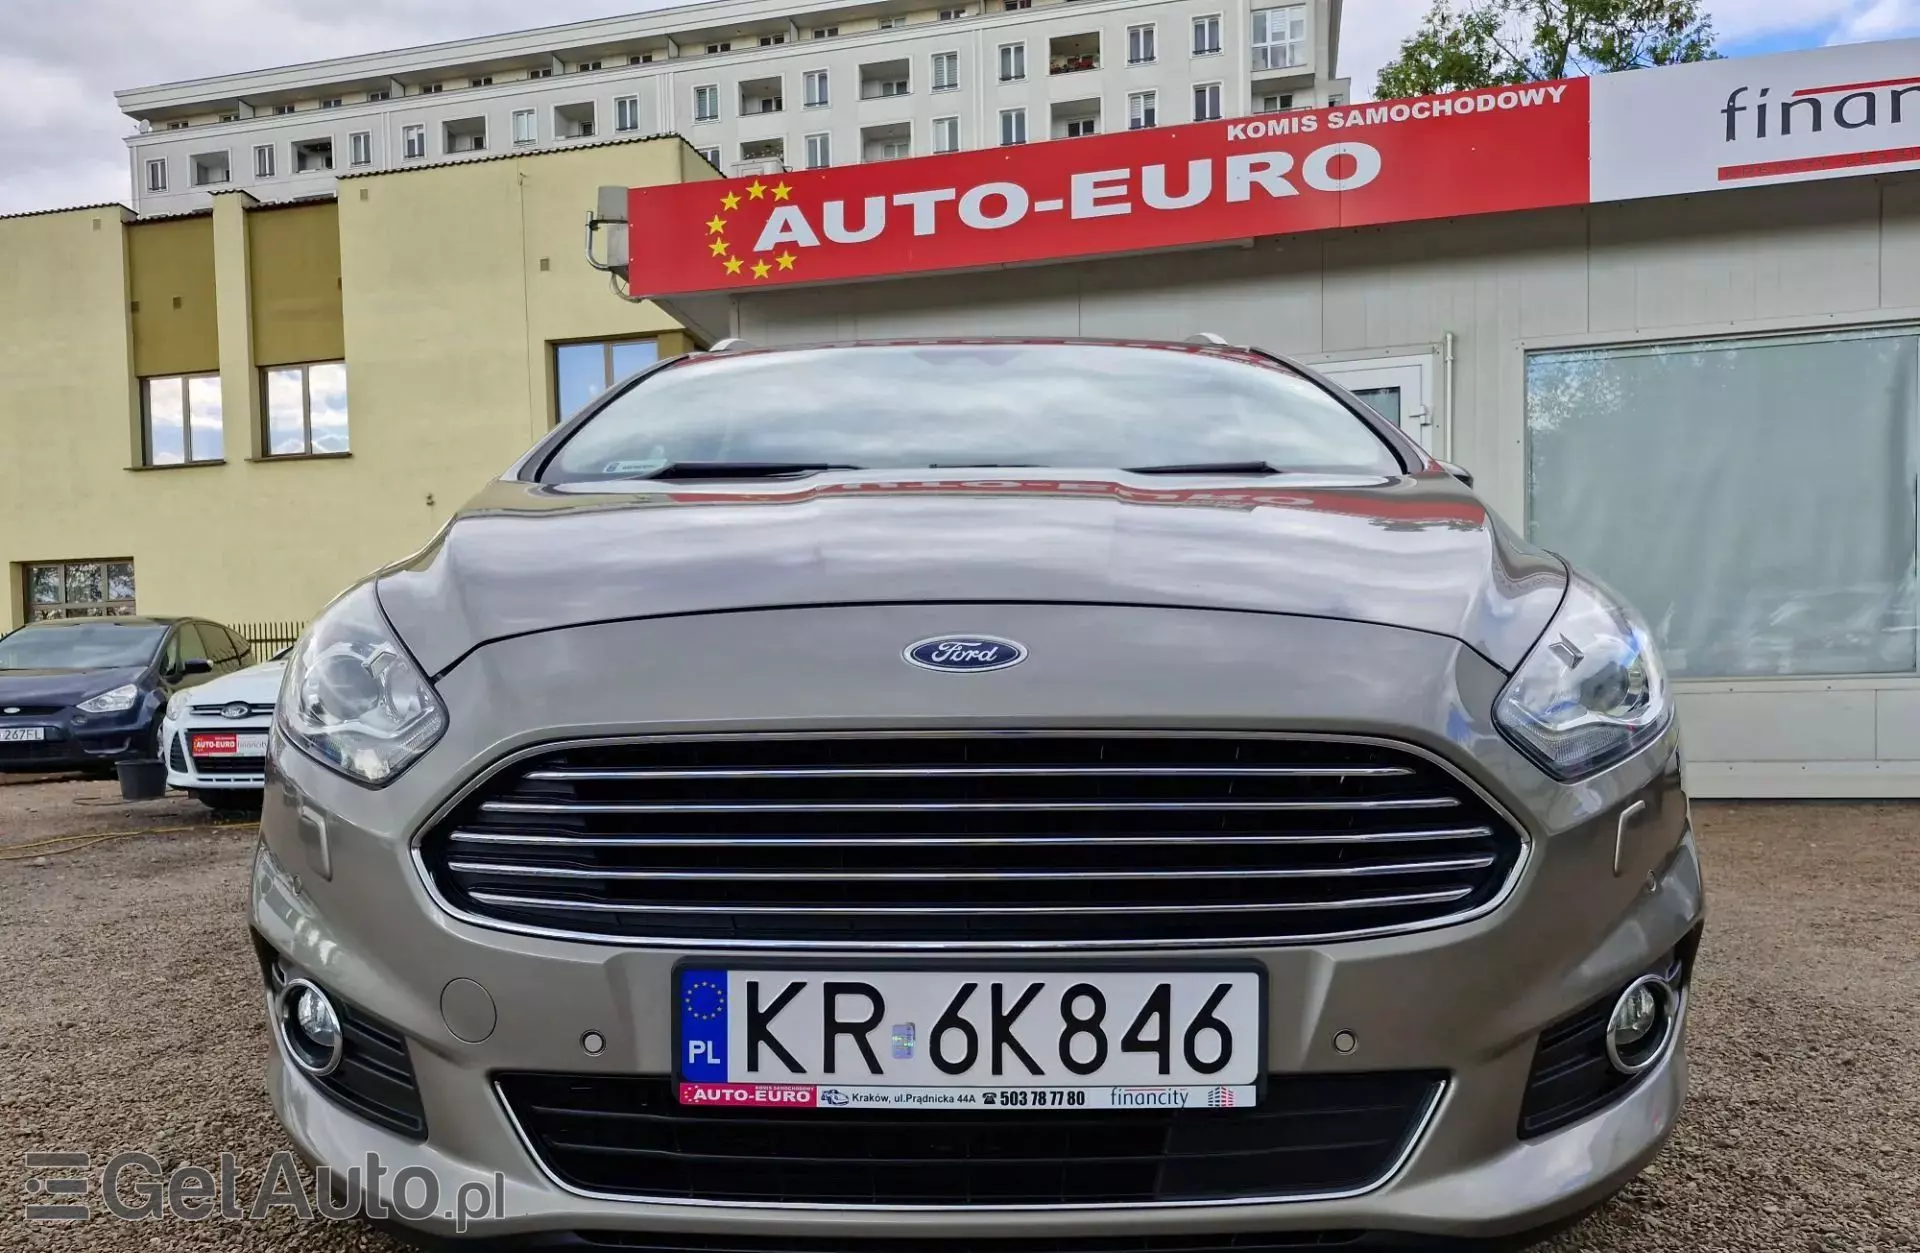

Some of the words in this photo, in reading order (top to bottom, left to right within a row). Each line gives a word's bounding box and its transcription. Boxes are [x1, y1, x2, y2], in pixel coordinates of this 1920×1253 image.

[1227, 115, 1318, 141] KOMIS
[1327, 84, 1567, 130] SAMOCHODOWY
[753, 140, 1382, 252] AUTO-EURO
[931, 641, 999, 663] Ford
[745, 981, 885, 1075] KR
[928, 982, 1234, 1076] 6K846
[688, 1040, 721, 1065] PL
[693, 1089, 811, 1103] AUTO-EURO
[852, 1092, 891, 1105] Kraków,
[957, 1094, 976, 1104] 44A
[1000, 1090, 1027, 1106] 503
[1030, 1090, 1047, 1106] 78
[1050, 1090, 1064, 1106] 77
[1067, 1090, 1085, 1106] 80
[1110, 1086, 1188, 1109] financity
